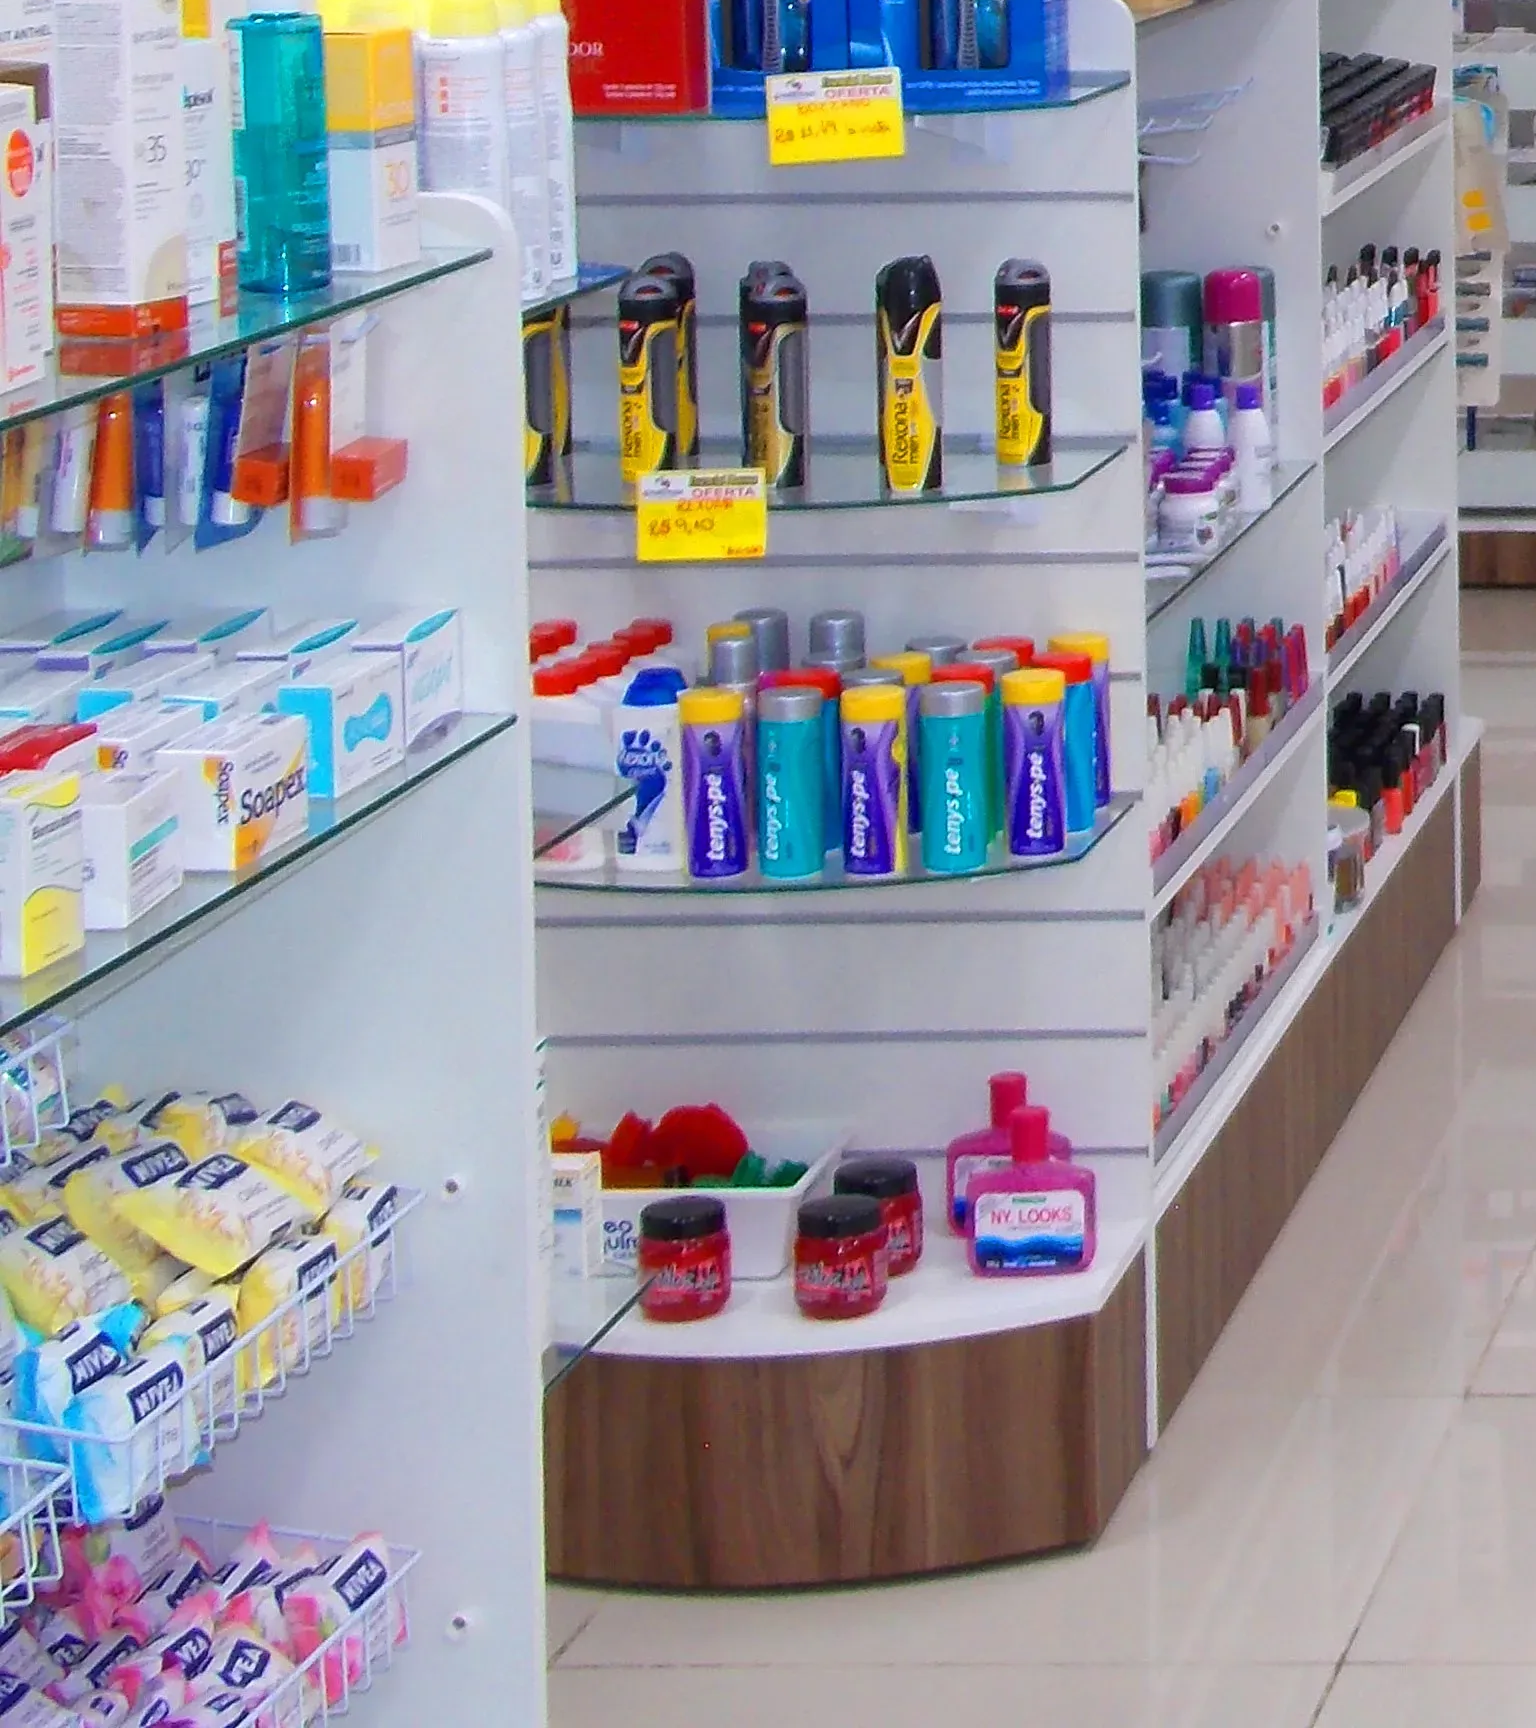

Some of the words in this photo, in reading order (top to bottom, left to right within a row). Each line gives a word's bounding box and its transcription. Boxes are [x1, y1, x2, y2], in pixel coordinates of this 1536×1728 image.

[892, 401, 908, 465] Rexona
[691, 487, 756, 498] OFERTA
[215, 761, 236, 825] Soapex
[239, 764, 308, 826] Soapex
[1018, 1204, 1073, 1224] LOOKS
